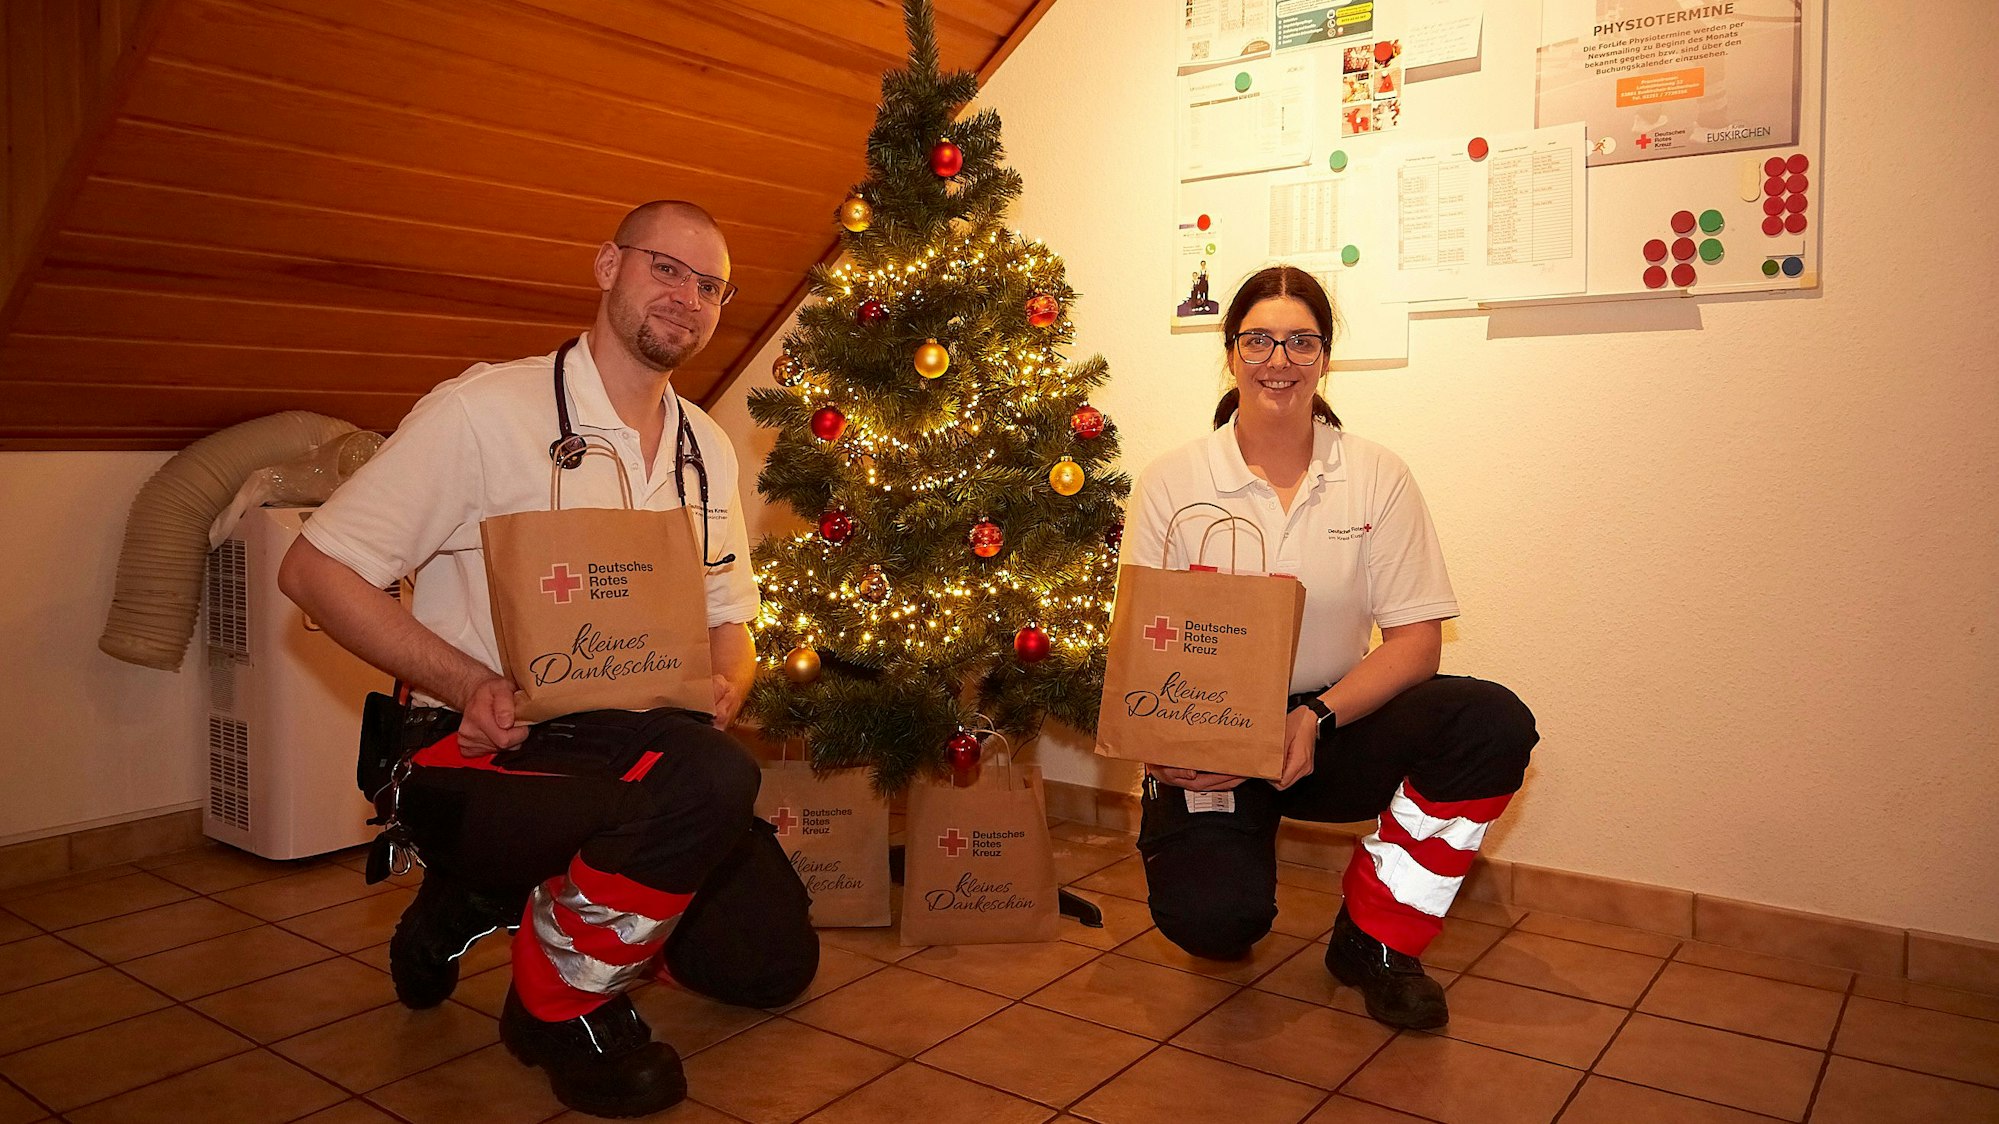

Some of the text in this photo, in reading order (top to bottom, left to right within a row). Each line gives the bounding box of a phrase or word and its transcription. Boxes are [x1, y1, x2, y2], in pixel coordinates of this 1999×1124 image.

[1593, 3, 1734, 36] PHYSIOTERMINE
[1583, 21, 1745, 53] Die ForLife Physiotermine werden per
[1588, 46, 1641, 60] Newsmailing
[1655, 40, 1686, 50] Beginn
[1688, 36, 1703, 44] des
[1705, 31, 1739, 41] Monats
[1584, 39, 1742, 69] bekannt gegeben bzw. sind über den
[1596, 50, 1729, 75] Buchungskalender einzusehen.
[1654, 129, 1686, 138] Deutsches
[1707, 126, 1771, 143] EUSKIRCHEN
[588, 561, 654, 574] Deutsches
[589, 575, 628, 587] Rotes
[590, 588, 629, 600] Kreuz
[1185, 620, 1248, 635] Deutsches
[571, 622, 649, 660] kleines
[1184, 631, 1218, 644] Rotes
[1183, 643, 1218, 655] Kreuz
[529, 650, 682, 687] Dankeschön
[1160, 671, 1228, 704] kleines
[1124, 690, 1254, 729] Dankeschön
[802, 808, 853, 817] Deutsches
[802, 818, 830, 826] Rotes
[802, 827, 830, 835] Kreuz
[973, 830, 1025, 839] Deutsches
[972, 840, 1002, 848] Rotes
[972, 849, 1002, 857] Kreuz
[806, 873, 864, 894] keschön
[955, 871, 1013, 897] kleines
[925, 889, 1036, 912] Dankeschön
